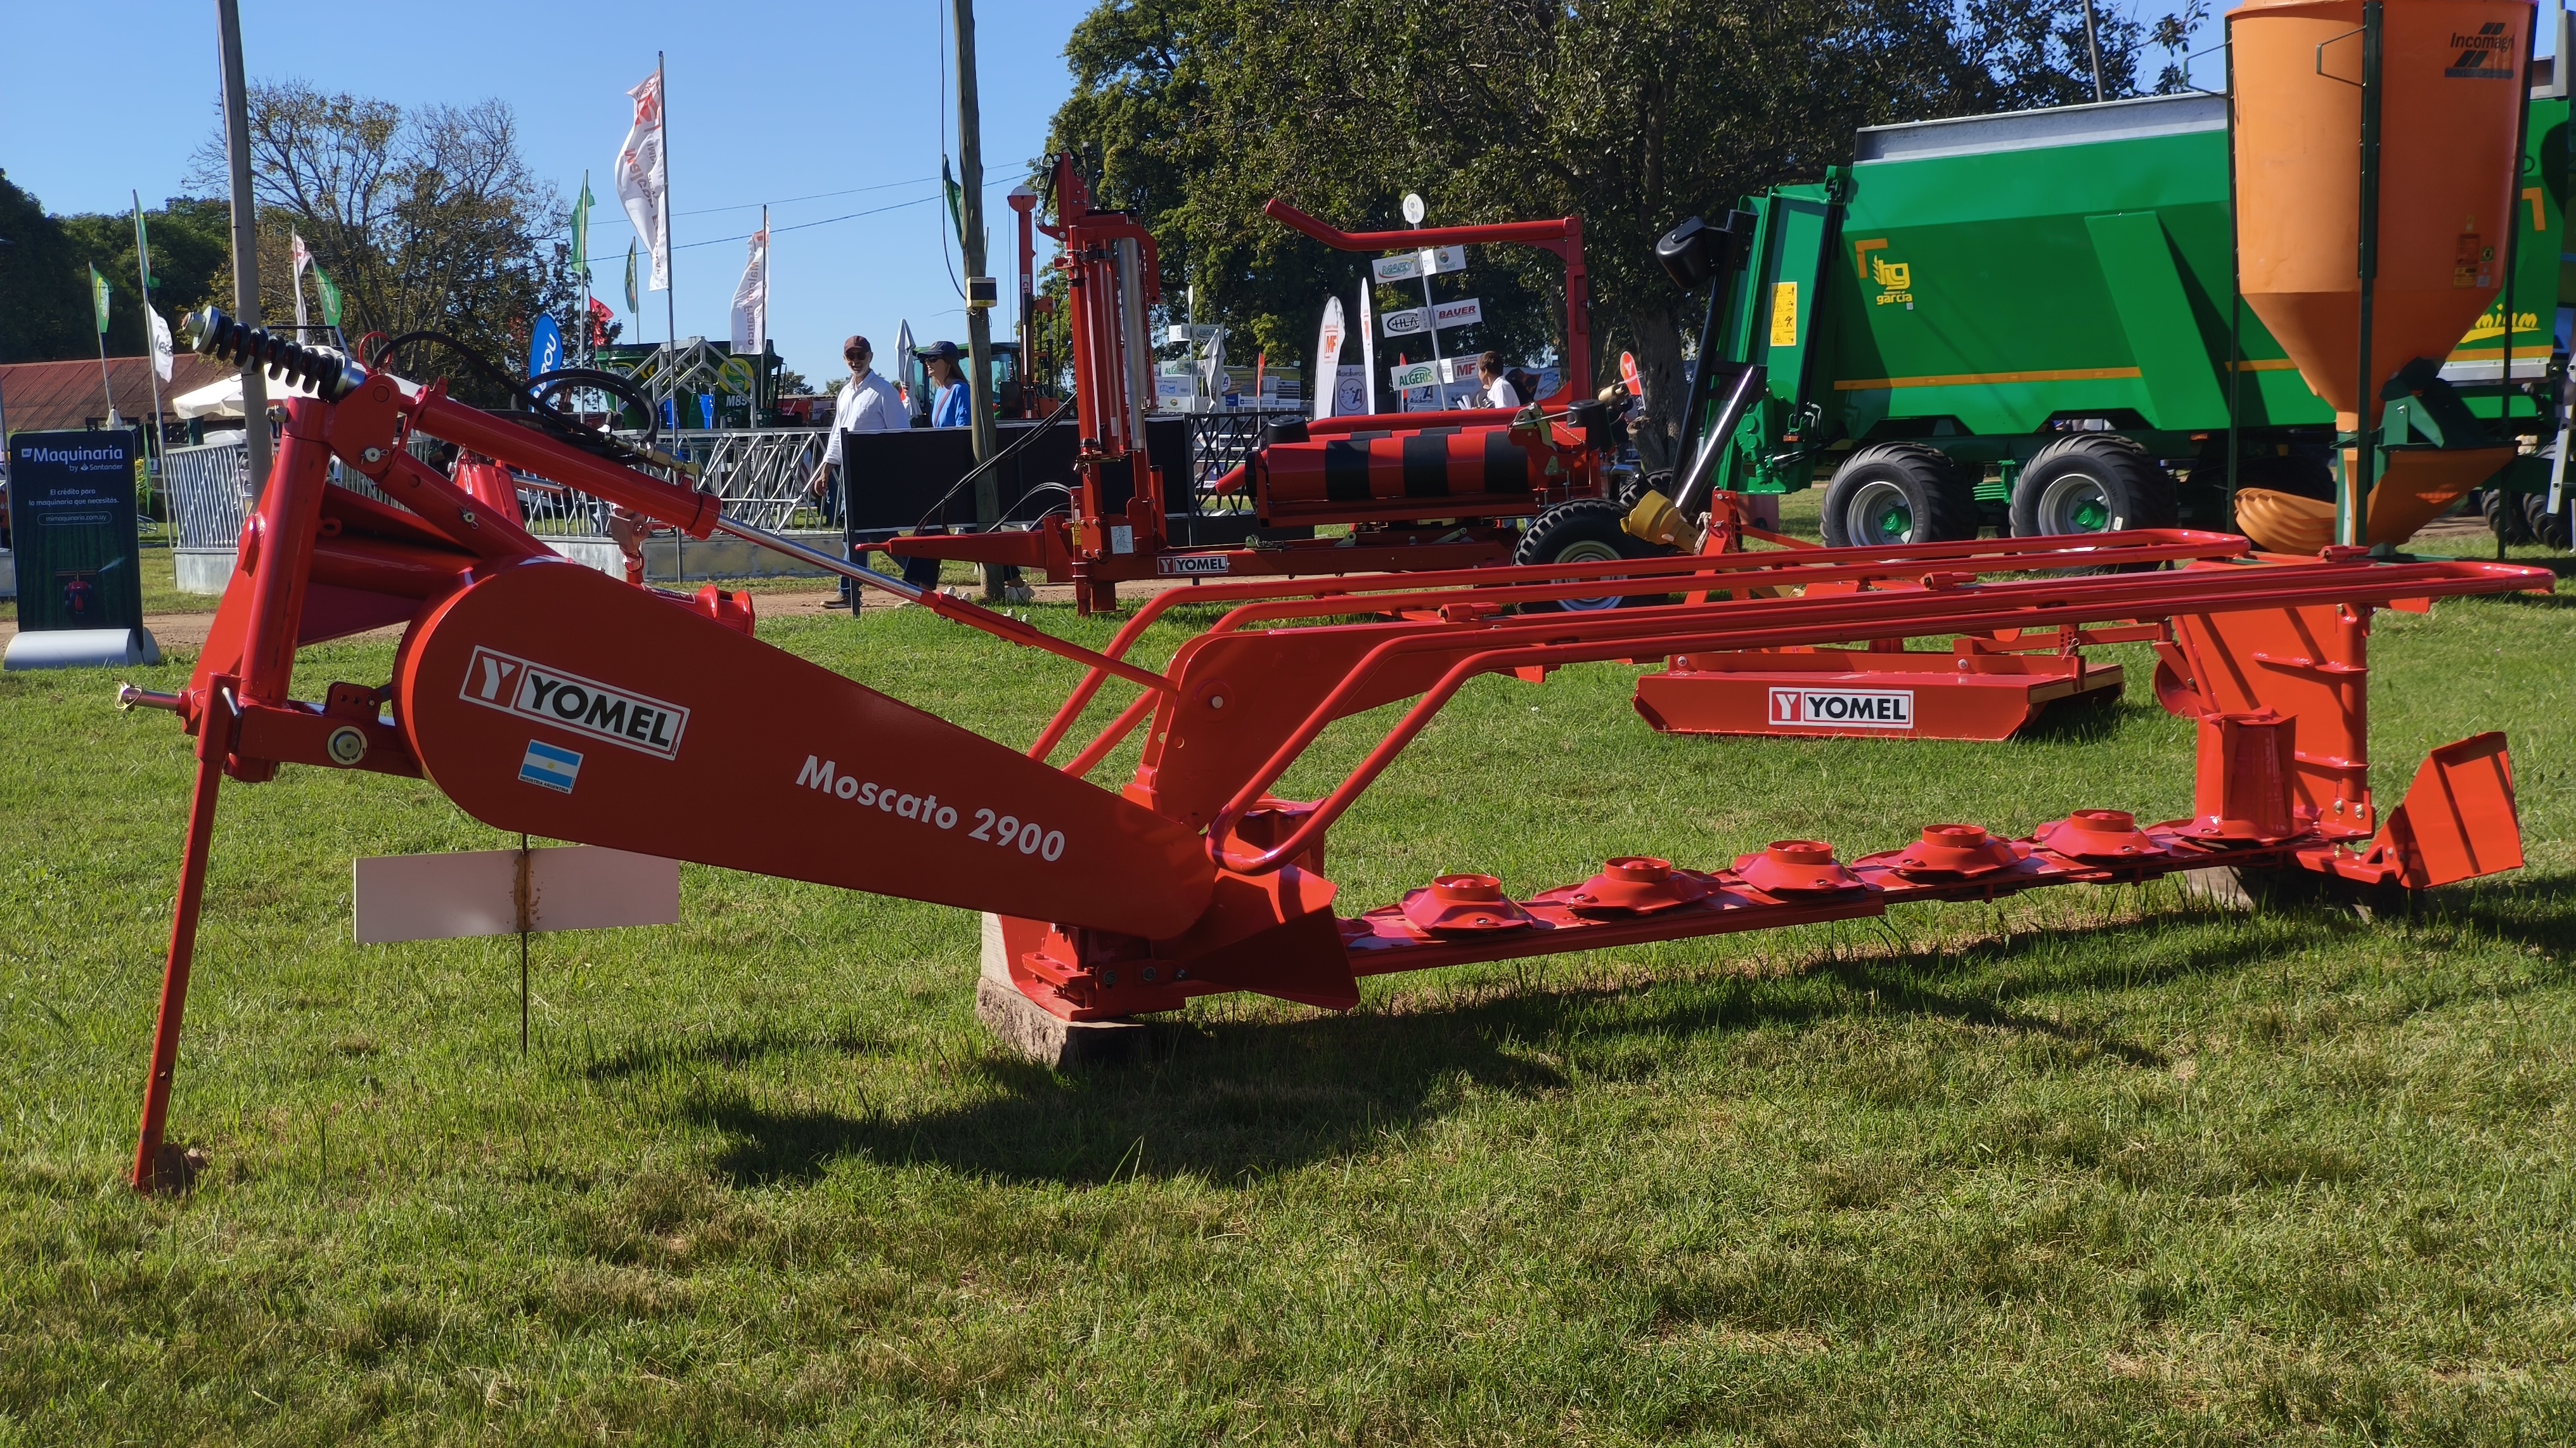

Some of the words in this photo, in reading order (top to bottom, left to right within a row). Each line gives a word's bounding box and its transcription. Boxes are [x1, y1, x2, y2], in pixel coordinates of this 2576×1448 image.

[2450, 32, 2515, 52] Incomagri
[1439, 306, 1476, 318] BAUER
[1325, 336, 1337, 353] MF
[1457, 363, 1476, 377] MF
[1400, 371, 1434, 386] ALGERIS
[726, 395, 747, 407] M85
[34, 444, 123, 465] Maquinaria
[69, 465, 79, 473] by
[36, 498, 73, 507] maquinaria
[1176, 559, 1225, 571] YOMEL
[530, 673, 670, 747] YOMEL
[1808, 696, 1907, 720] YOMEL
[544, 782, 569, 792] ARGENTINA
[796, 754, 958, 829] Moscato
[969, 808, 1065, 862] 2900
